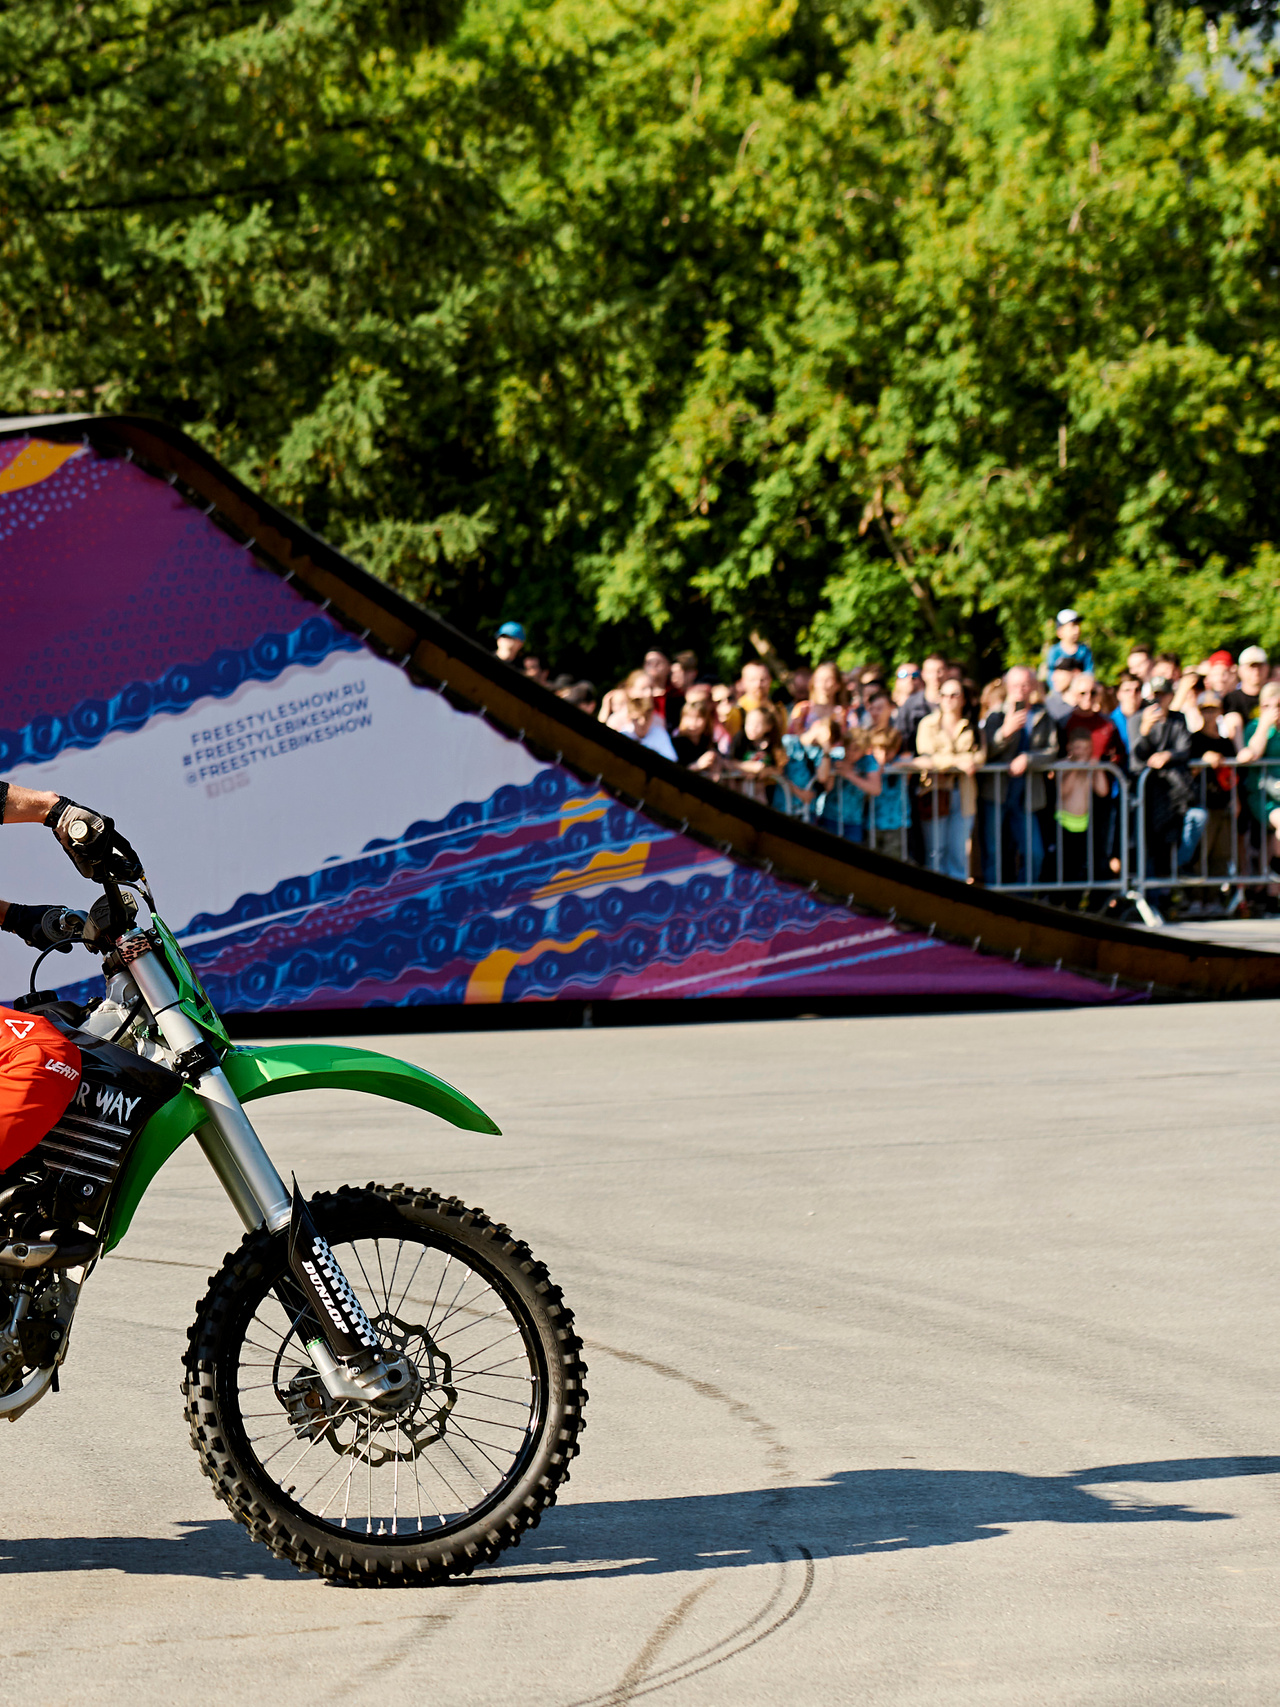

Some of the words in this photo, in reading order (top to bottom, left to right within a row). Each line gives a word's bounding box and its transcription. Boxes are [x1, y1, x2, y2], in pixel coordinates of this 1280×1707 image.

[191, 680, 366, 747] FREESTYLESHOW.RU
[45, 1058, 80, 1081] LEATT
[96, 1086, 142, 1125] WAY
[301, 1260, 350, 1334] DUNLOP
